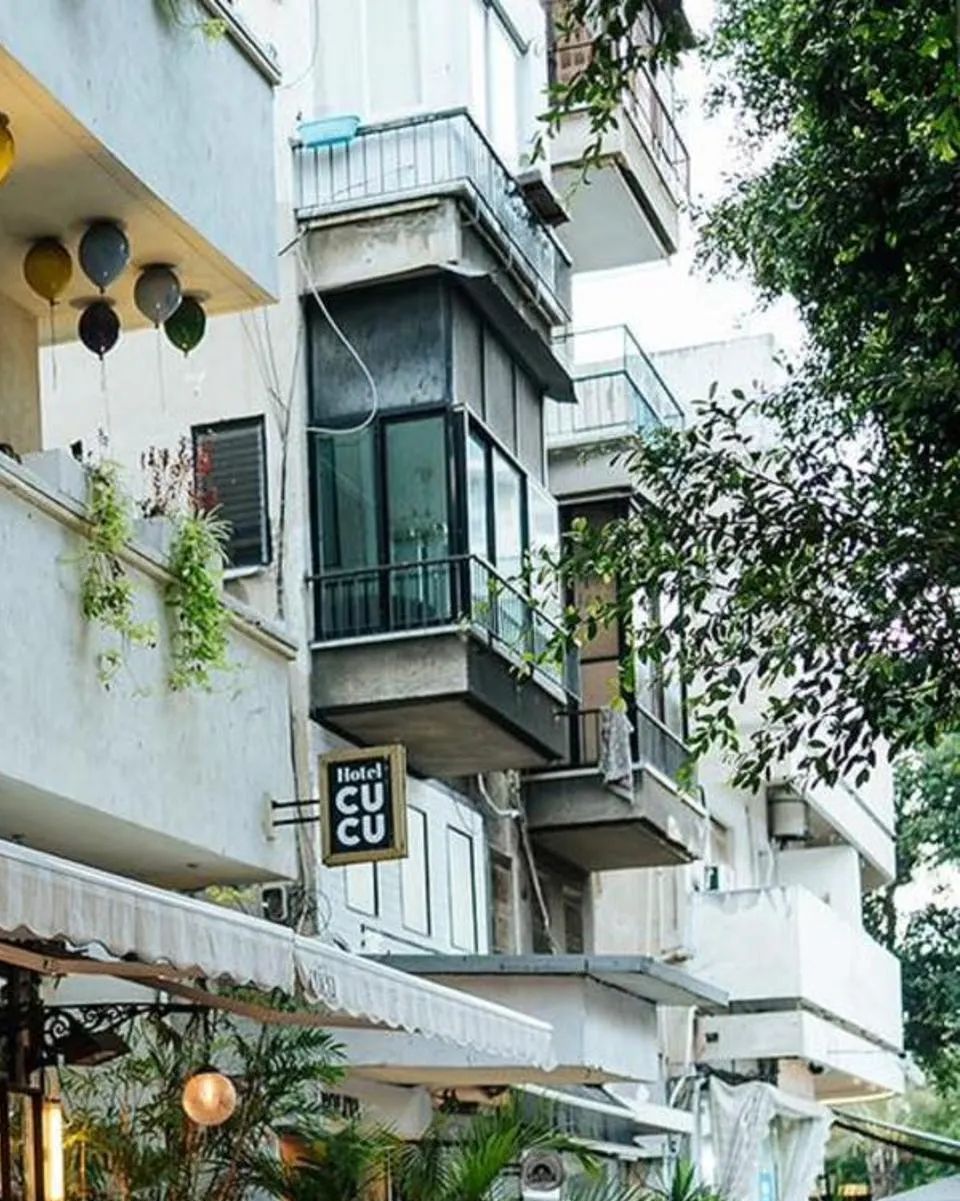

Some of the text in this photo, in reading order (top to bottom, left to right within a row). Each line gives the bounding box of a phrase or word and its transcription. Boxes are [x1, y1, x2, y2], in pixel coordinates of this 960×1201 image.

[336, 762, 383, 783] Hotel
[335, 782, 384, 815] CU
[336, 814, 386, 846] CU
